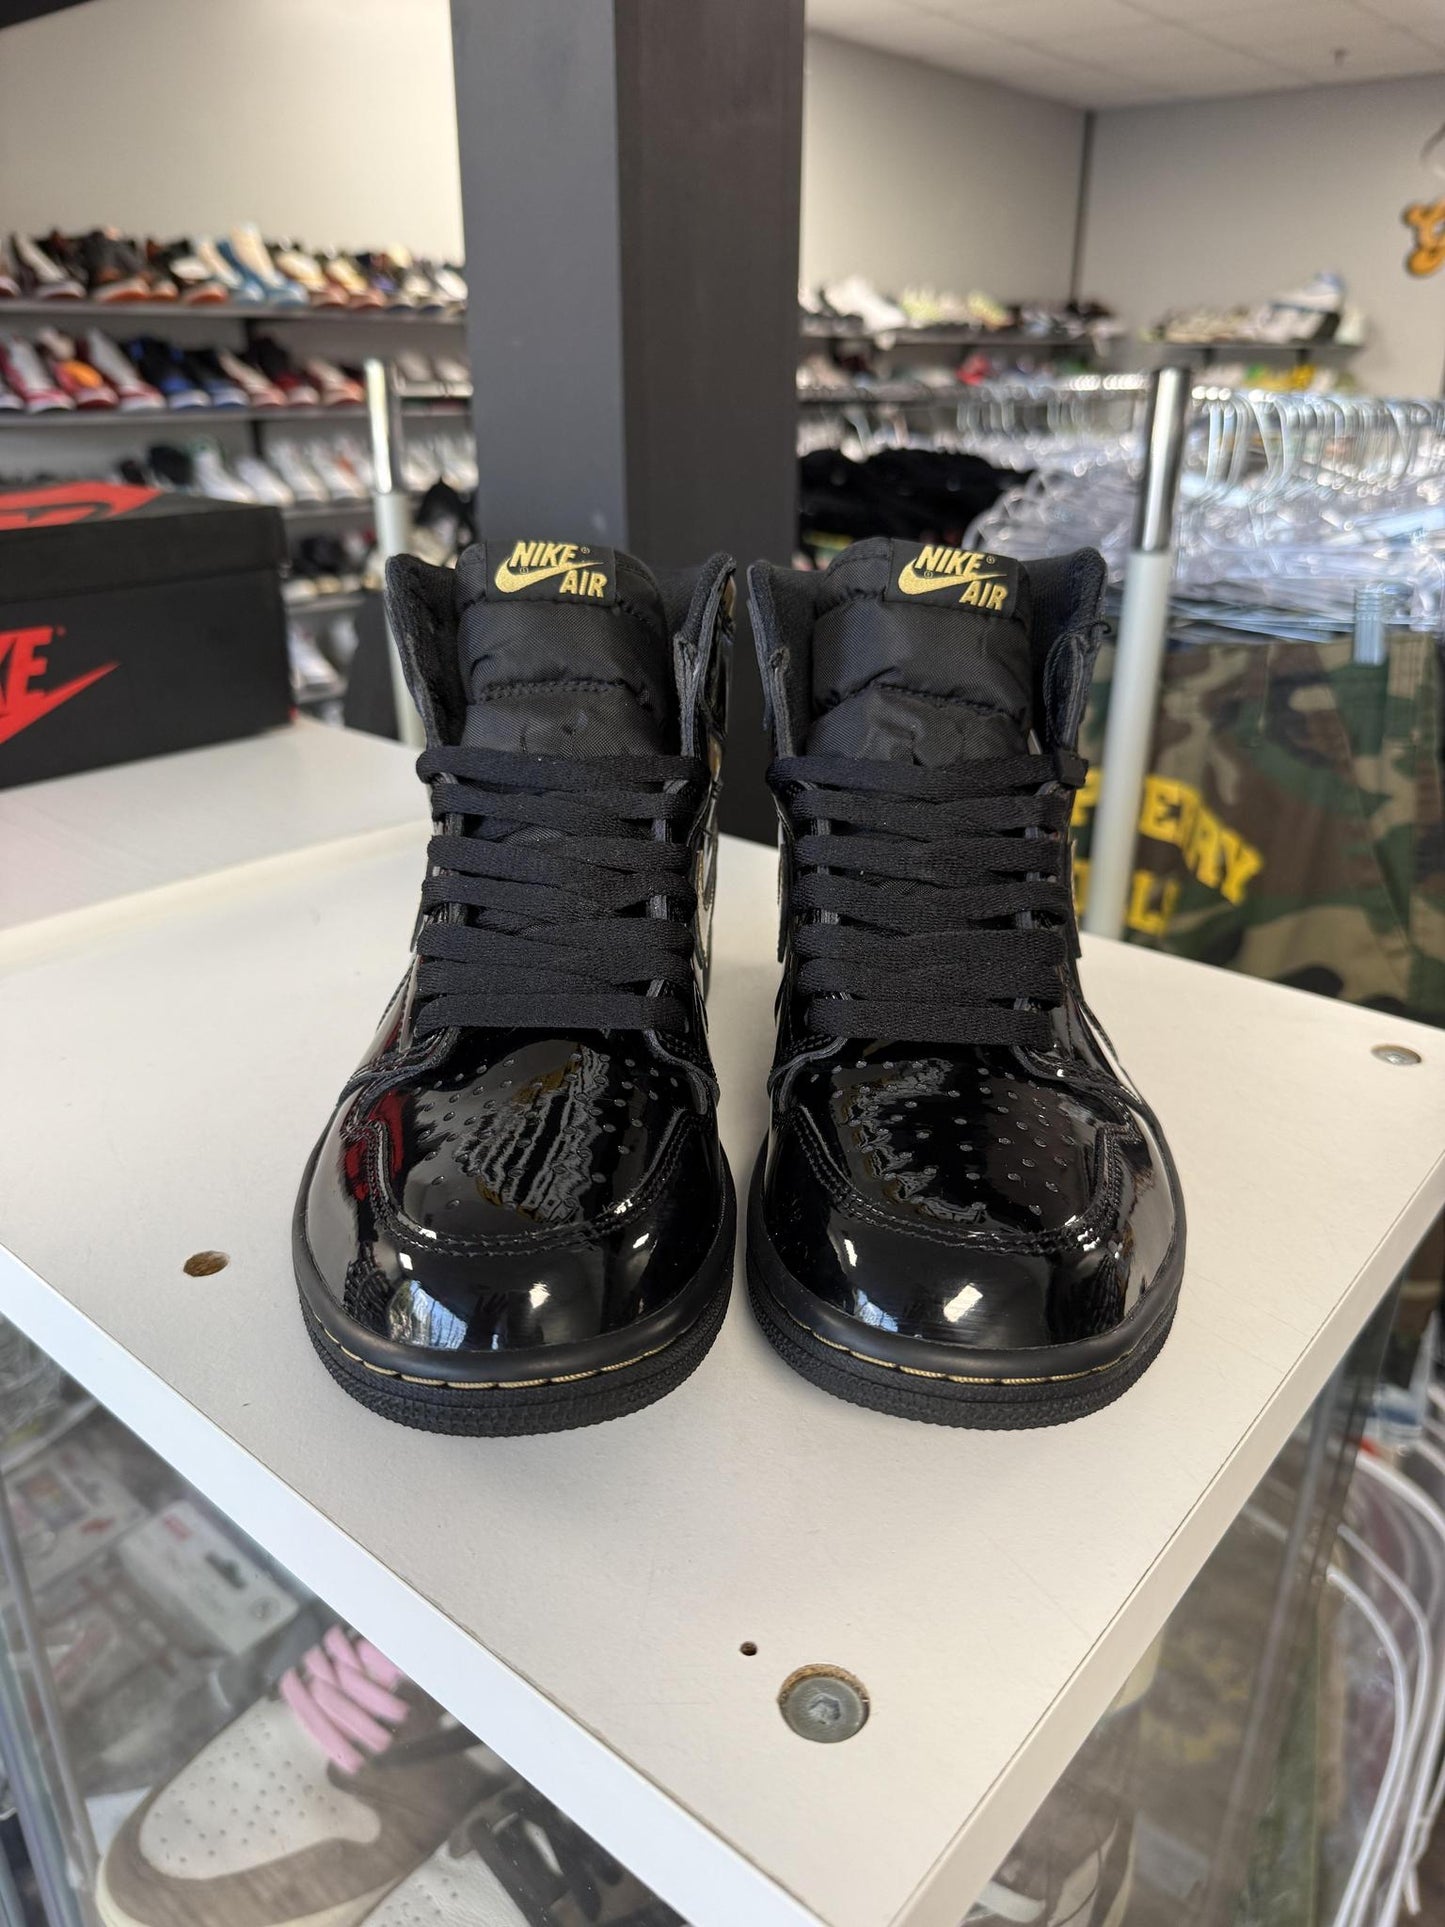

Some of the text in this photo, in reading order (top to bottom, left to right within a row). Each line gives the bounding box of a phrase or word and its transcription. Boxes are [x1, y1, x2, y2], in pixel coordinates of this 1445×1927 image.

[508, 540, 579, 568] NIKE
[914, 544, 985, 577] NIKE
[559, 569, 608, 598] AIR
[958, 580, 1008, 611] AIR
